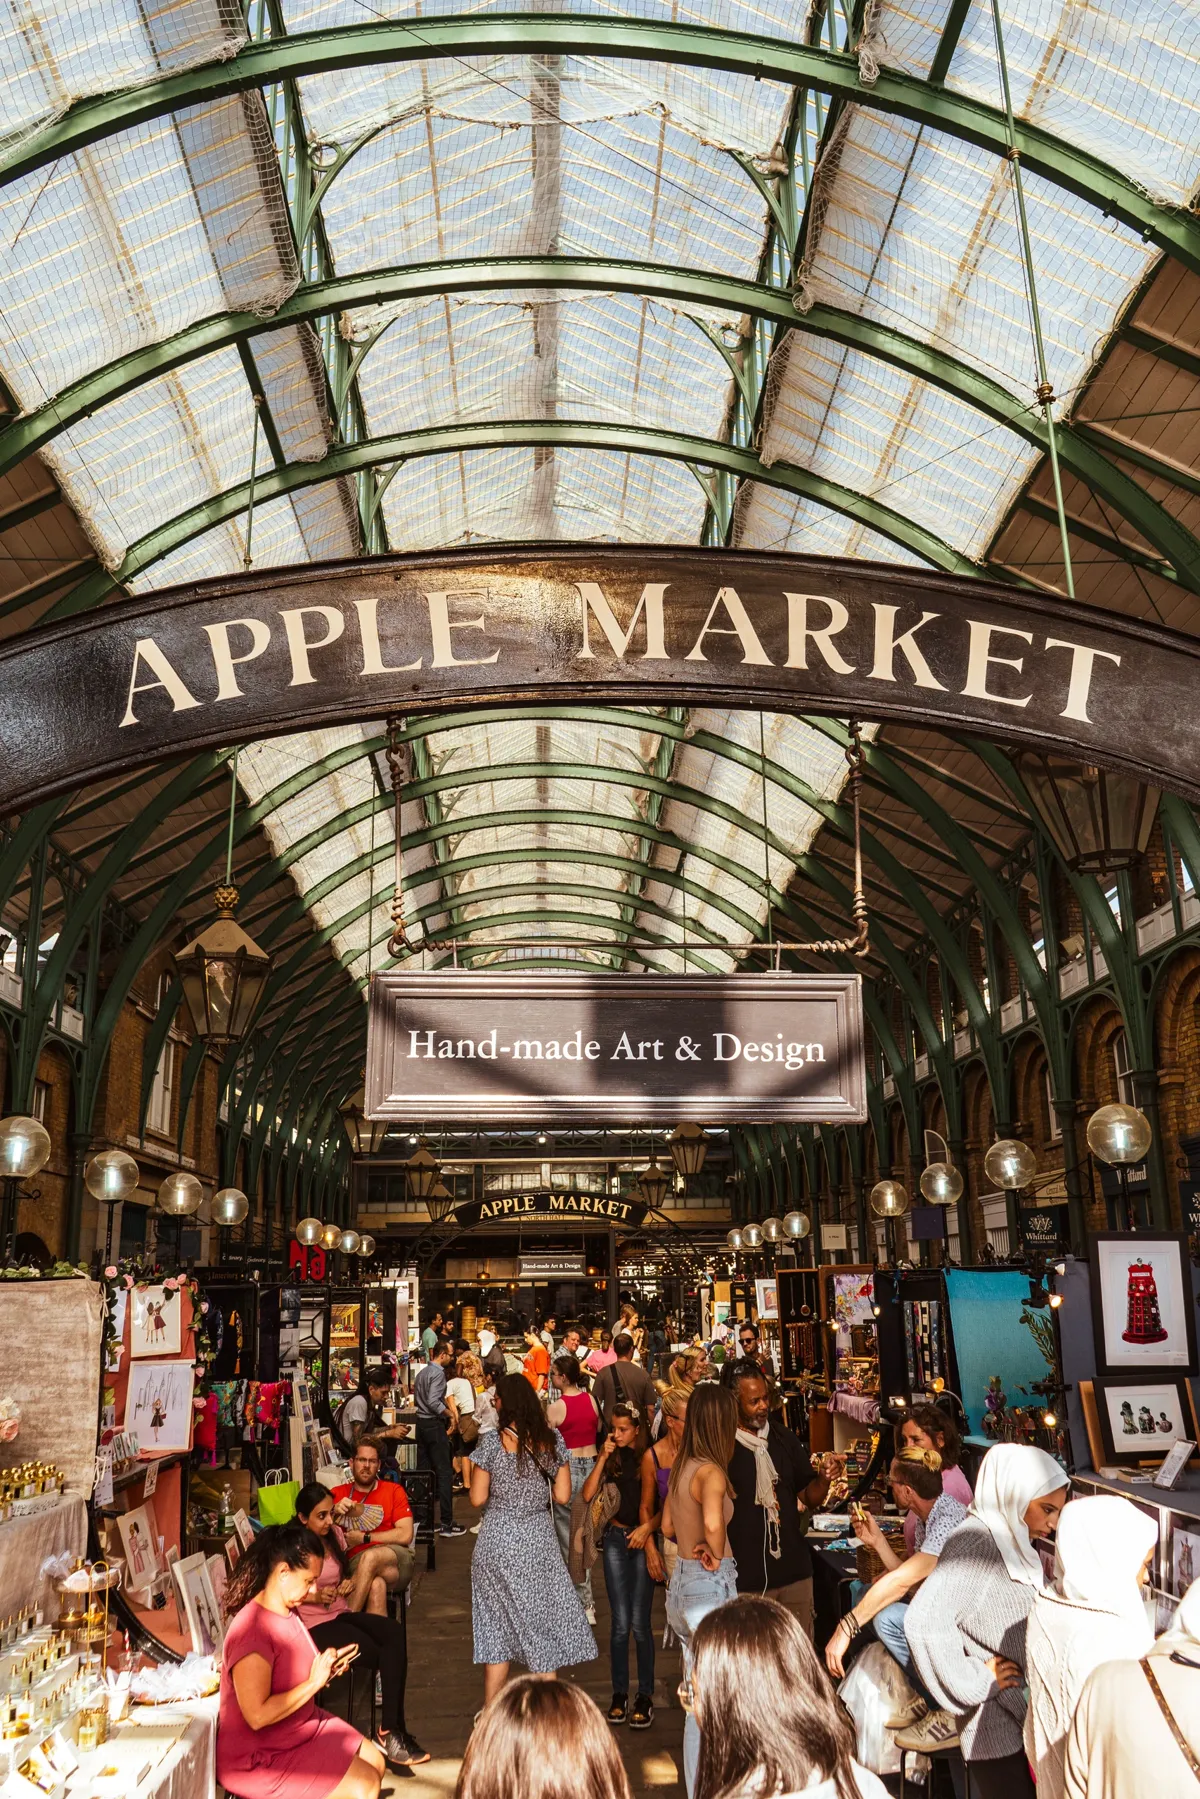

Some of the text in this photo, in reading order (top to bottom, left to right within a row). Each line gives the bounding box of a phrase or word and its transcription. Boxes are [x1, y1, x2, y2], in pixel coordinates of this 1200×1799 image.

[118, 582, 1122, 728] APPLE MARKET
[407, 1029, 827, 1071] Hand-made Art & Design
[479, 1195, 632, 1219] APPLE MARKET
[1025, 1232, 1058, 1241] Whittard
[564, 1262, 581, 1270] Design
